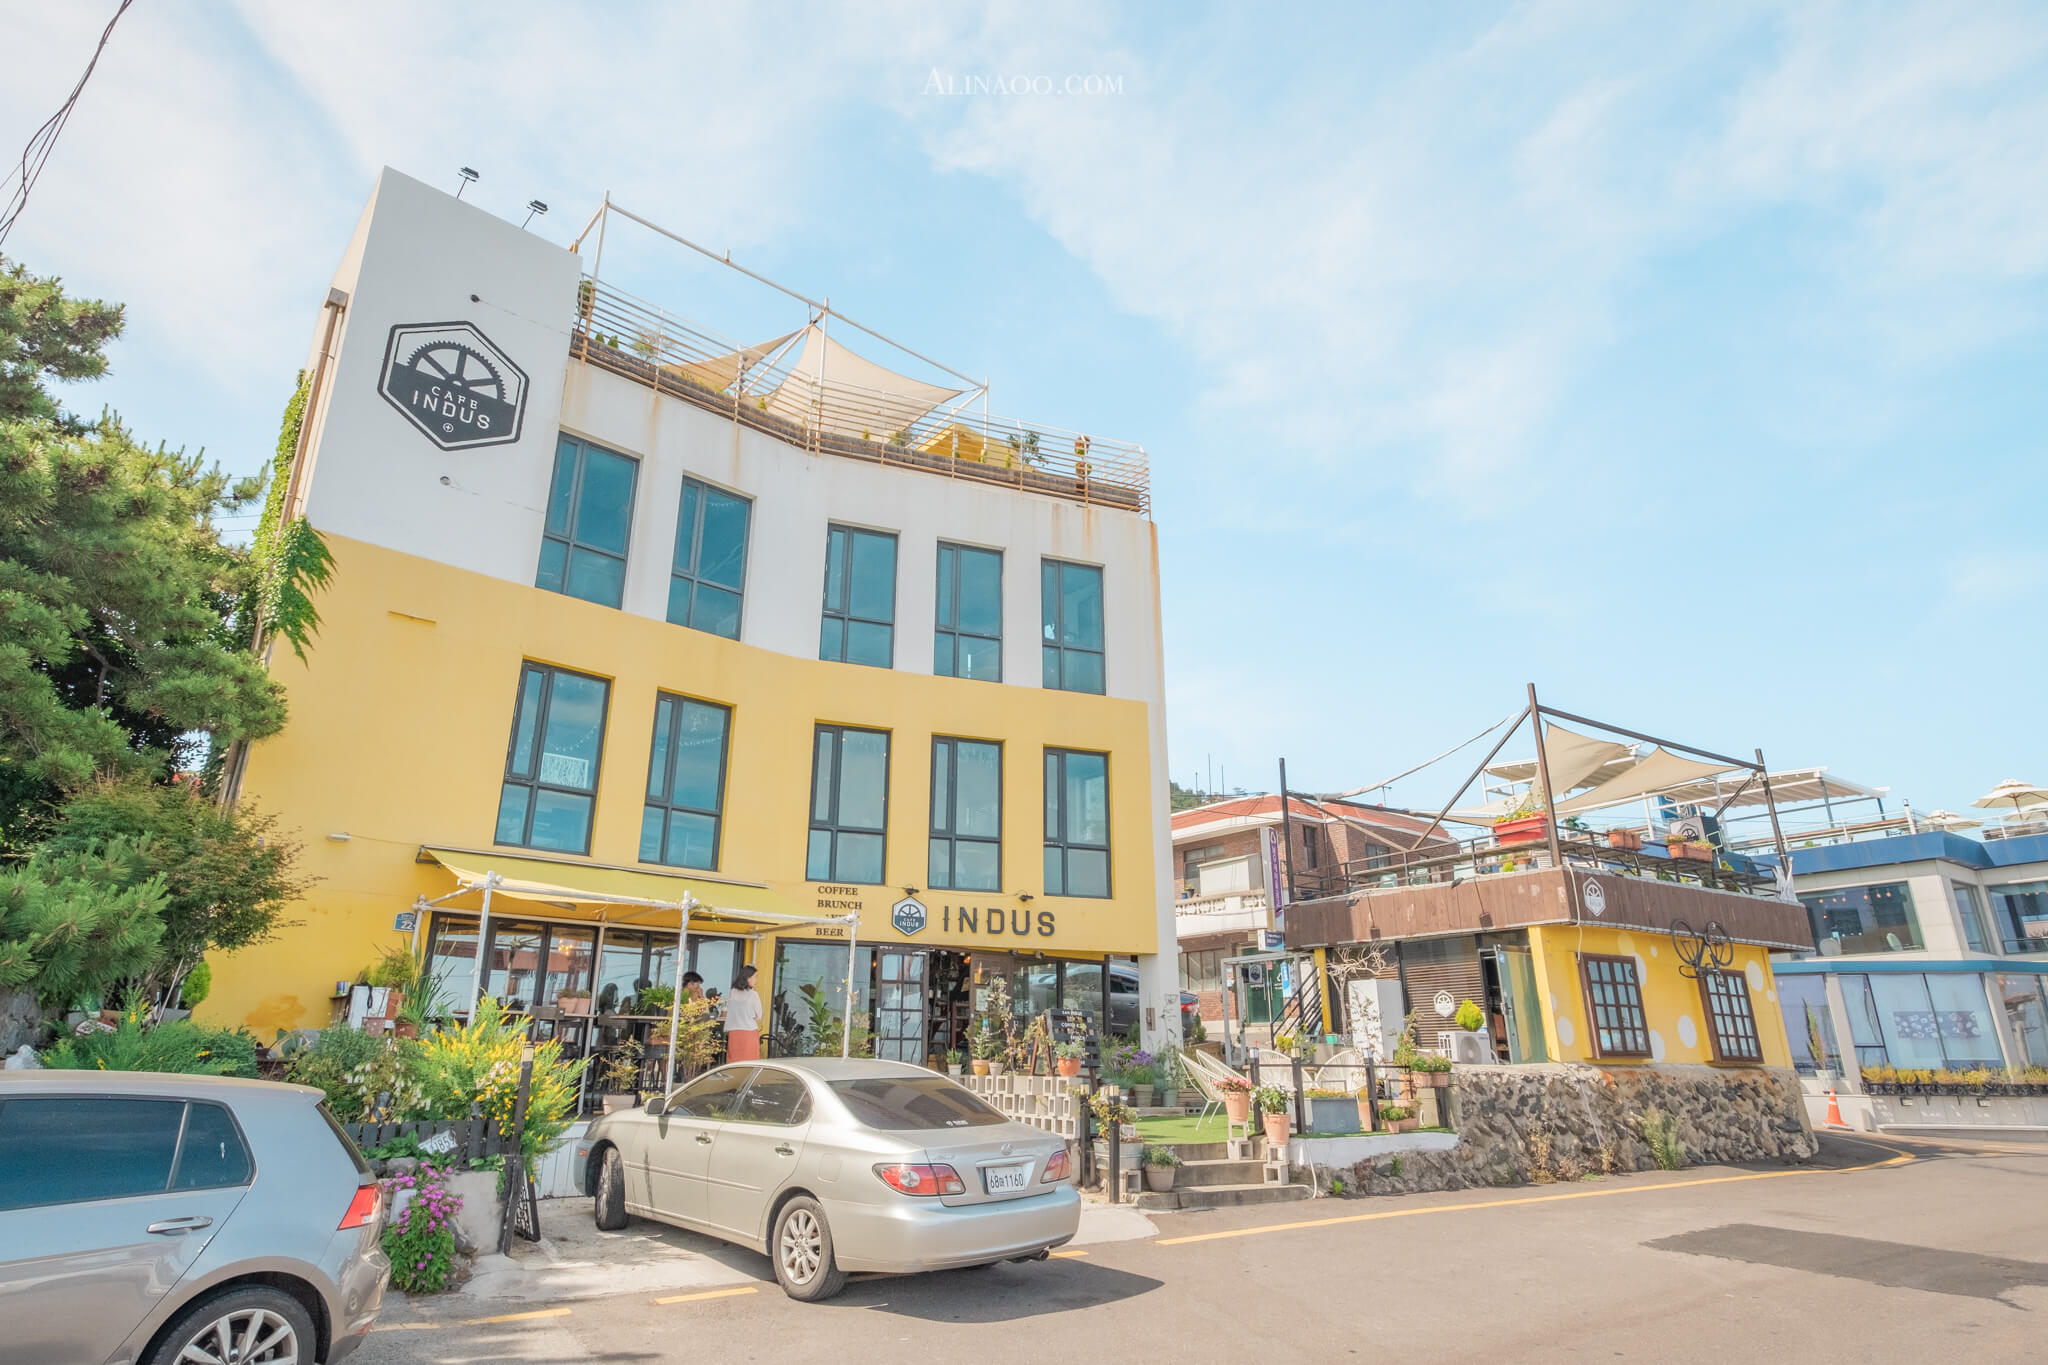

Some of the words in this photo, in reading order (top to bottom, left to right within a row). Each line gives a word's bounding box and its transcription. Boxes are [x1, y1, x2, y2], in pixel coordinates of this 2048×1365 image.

[431, 386, 479, 410] CAFE
[412, 390, 490, 430] INDUS
[817, 885, 859, 896] COFFEE
[817, 899, 863, 910] BRUNCH
[943, 905, 1056, 937] INDUS
[815, 927, 844, 937] BEER
